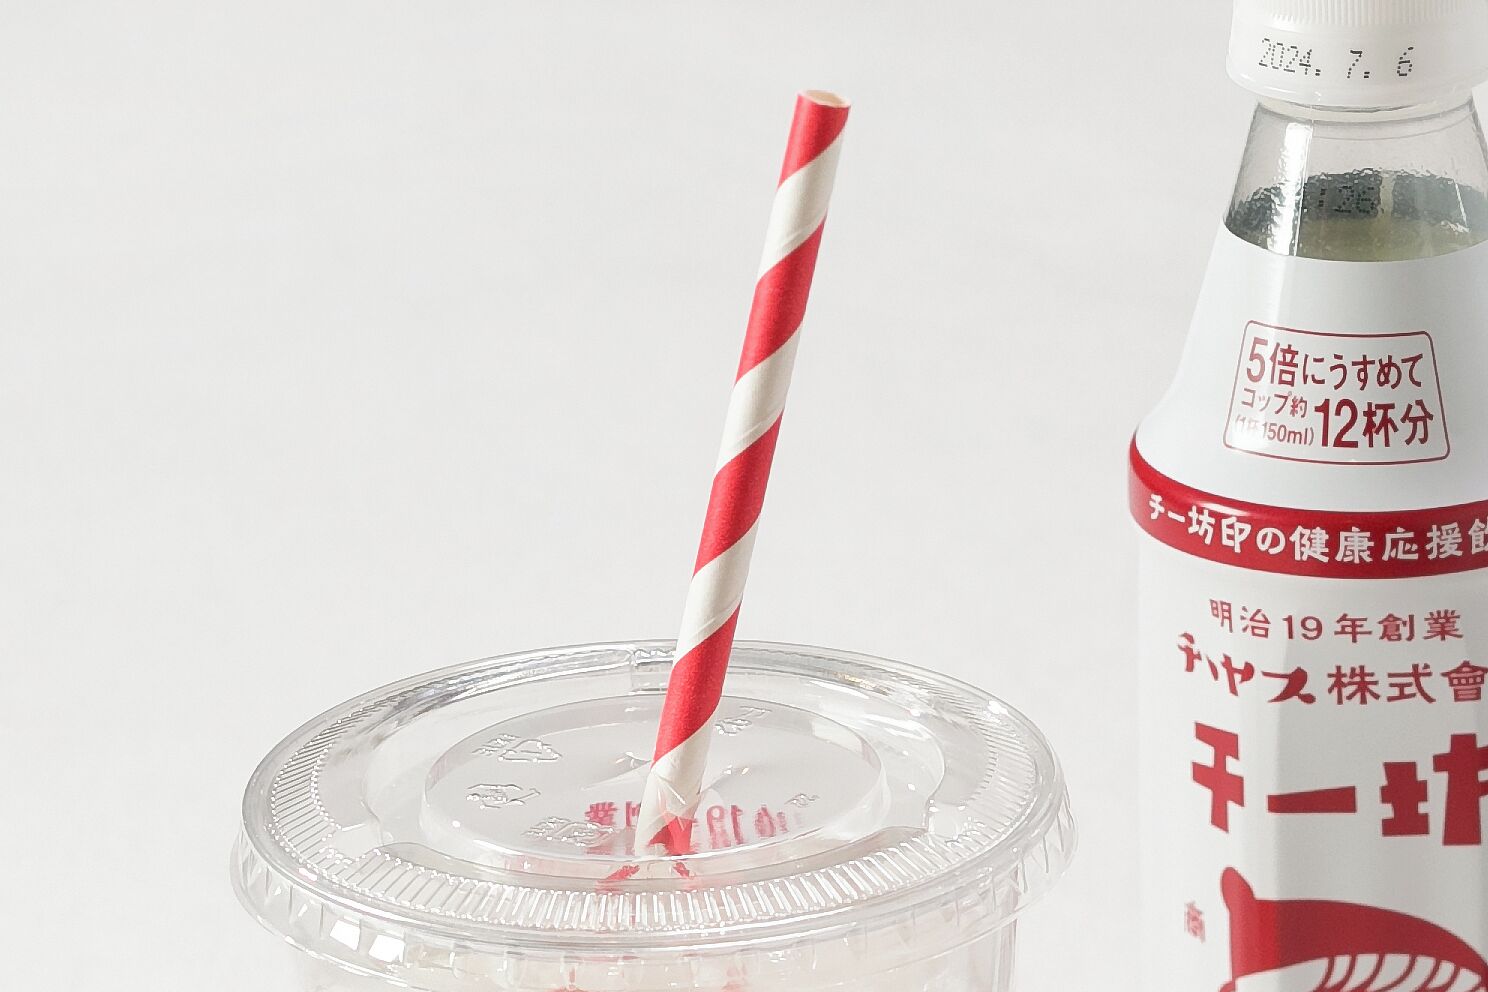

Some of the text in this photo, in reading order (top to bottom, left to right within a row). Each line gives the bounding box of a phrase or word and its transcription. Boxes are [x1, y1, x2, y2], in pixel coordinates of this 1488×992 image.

[1397, 47, 1413, 77] 6
[1246, 337, 1423, 391] 5倍にうすめて
[1241, 388, 1308, 418] コップ約
[1314, 398, 1434, 448] 12杯分
[1209, 598, 1464, 643] 明治19年創業
